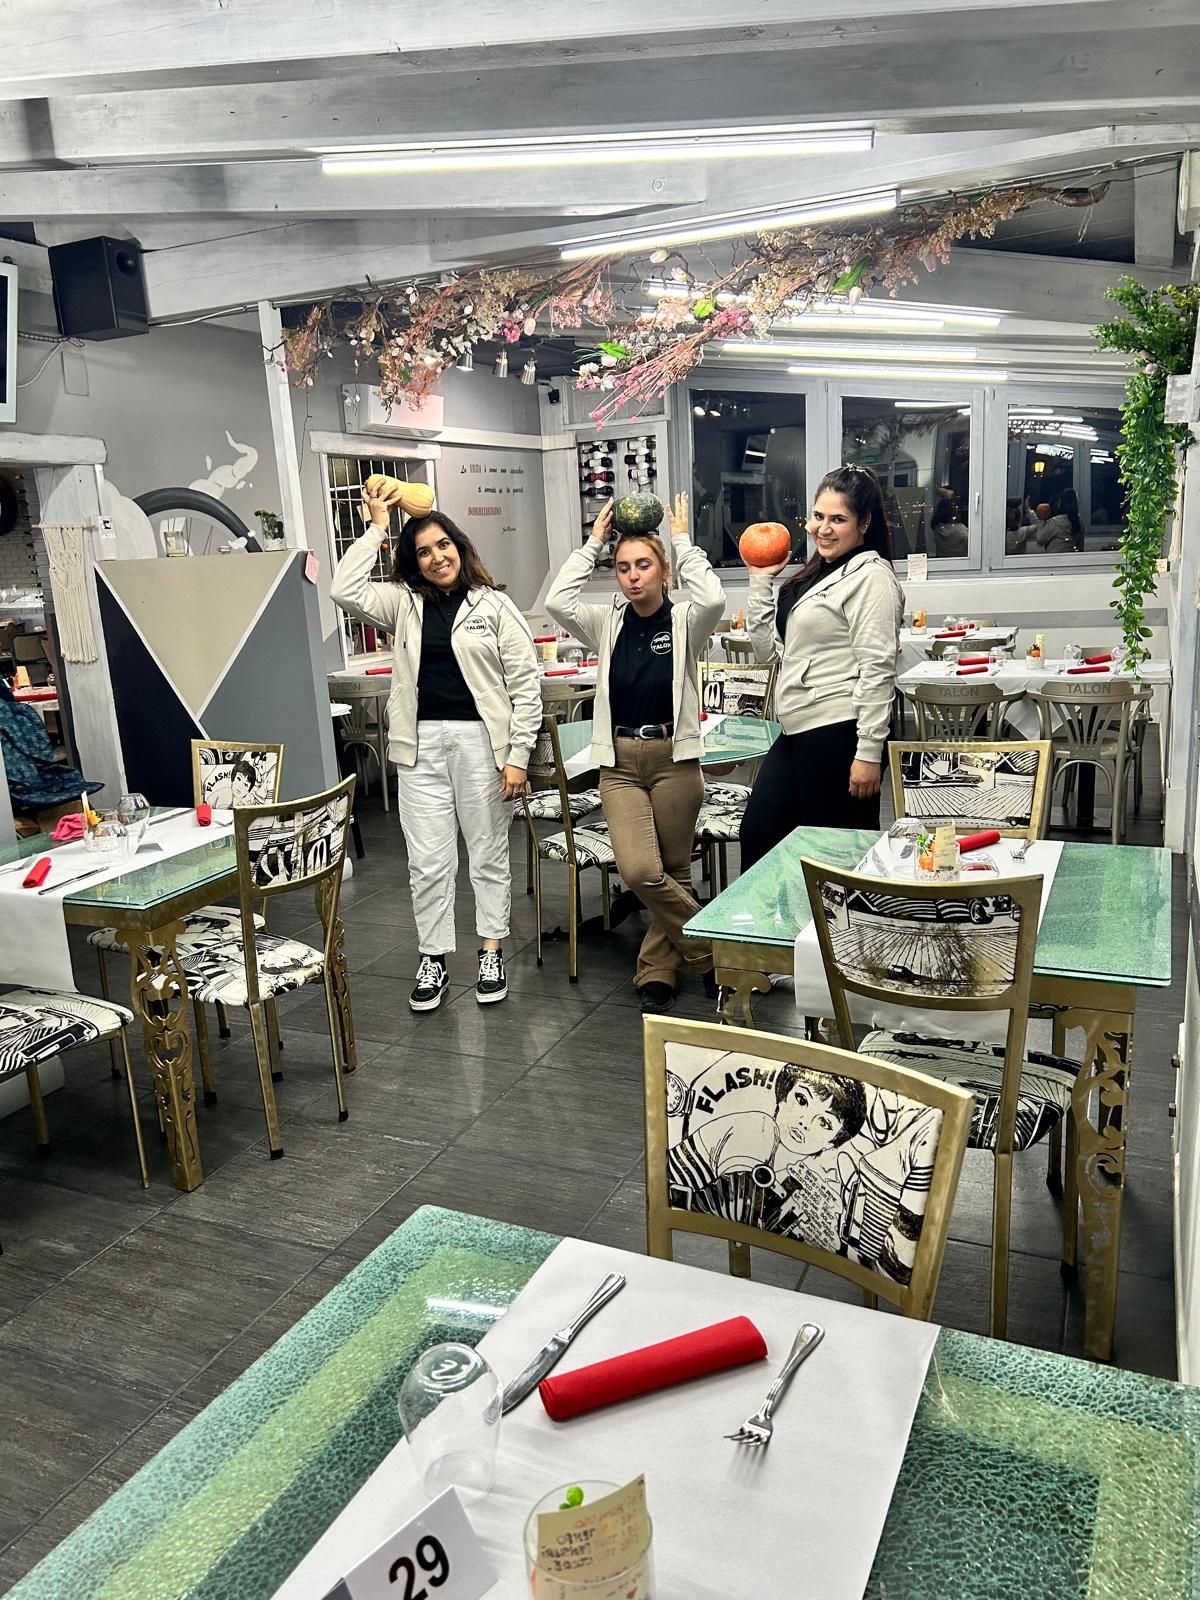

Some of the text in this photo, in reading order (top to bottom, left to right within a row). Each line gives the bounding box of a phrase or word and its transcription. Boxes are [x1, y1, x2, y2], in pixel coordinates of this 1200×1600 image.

[938, 686, 979, 697] TALON
[1066, 683, 1111, 695] TALON
[695, 1067, 777, 1115] FLASH!
[389, 1534, 450, 1600] 29
